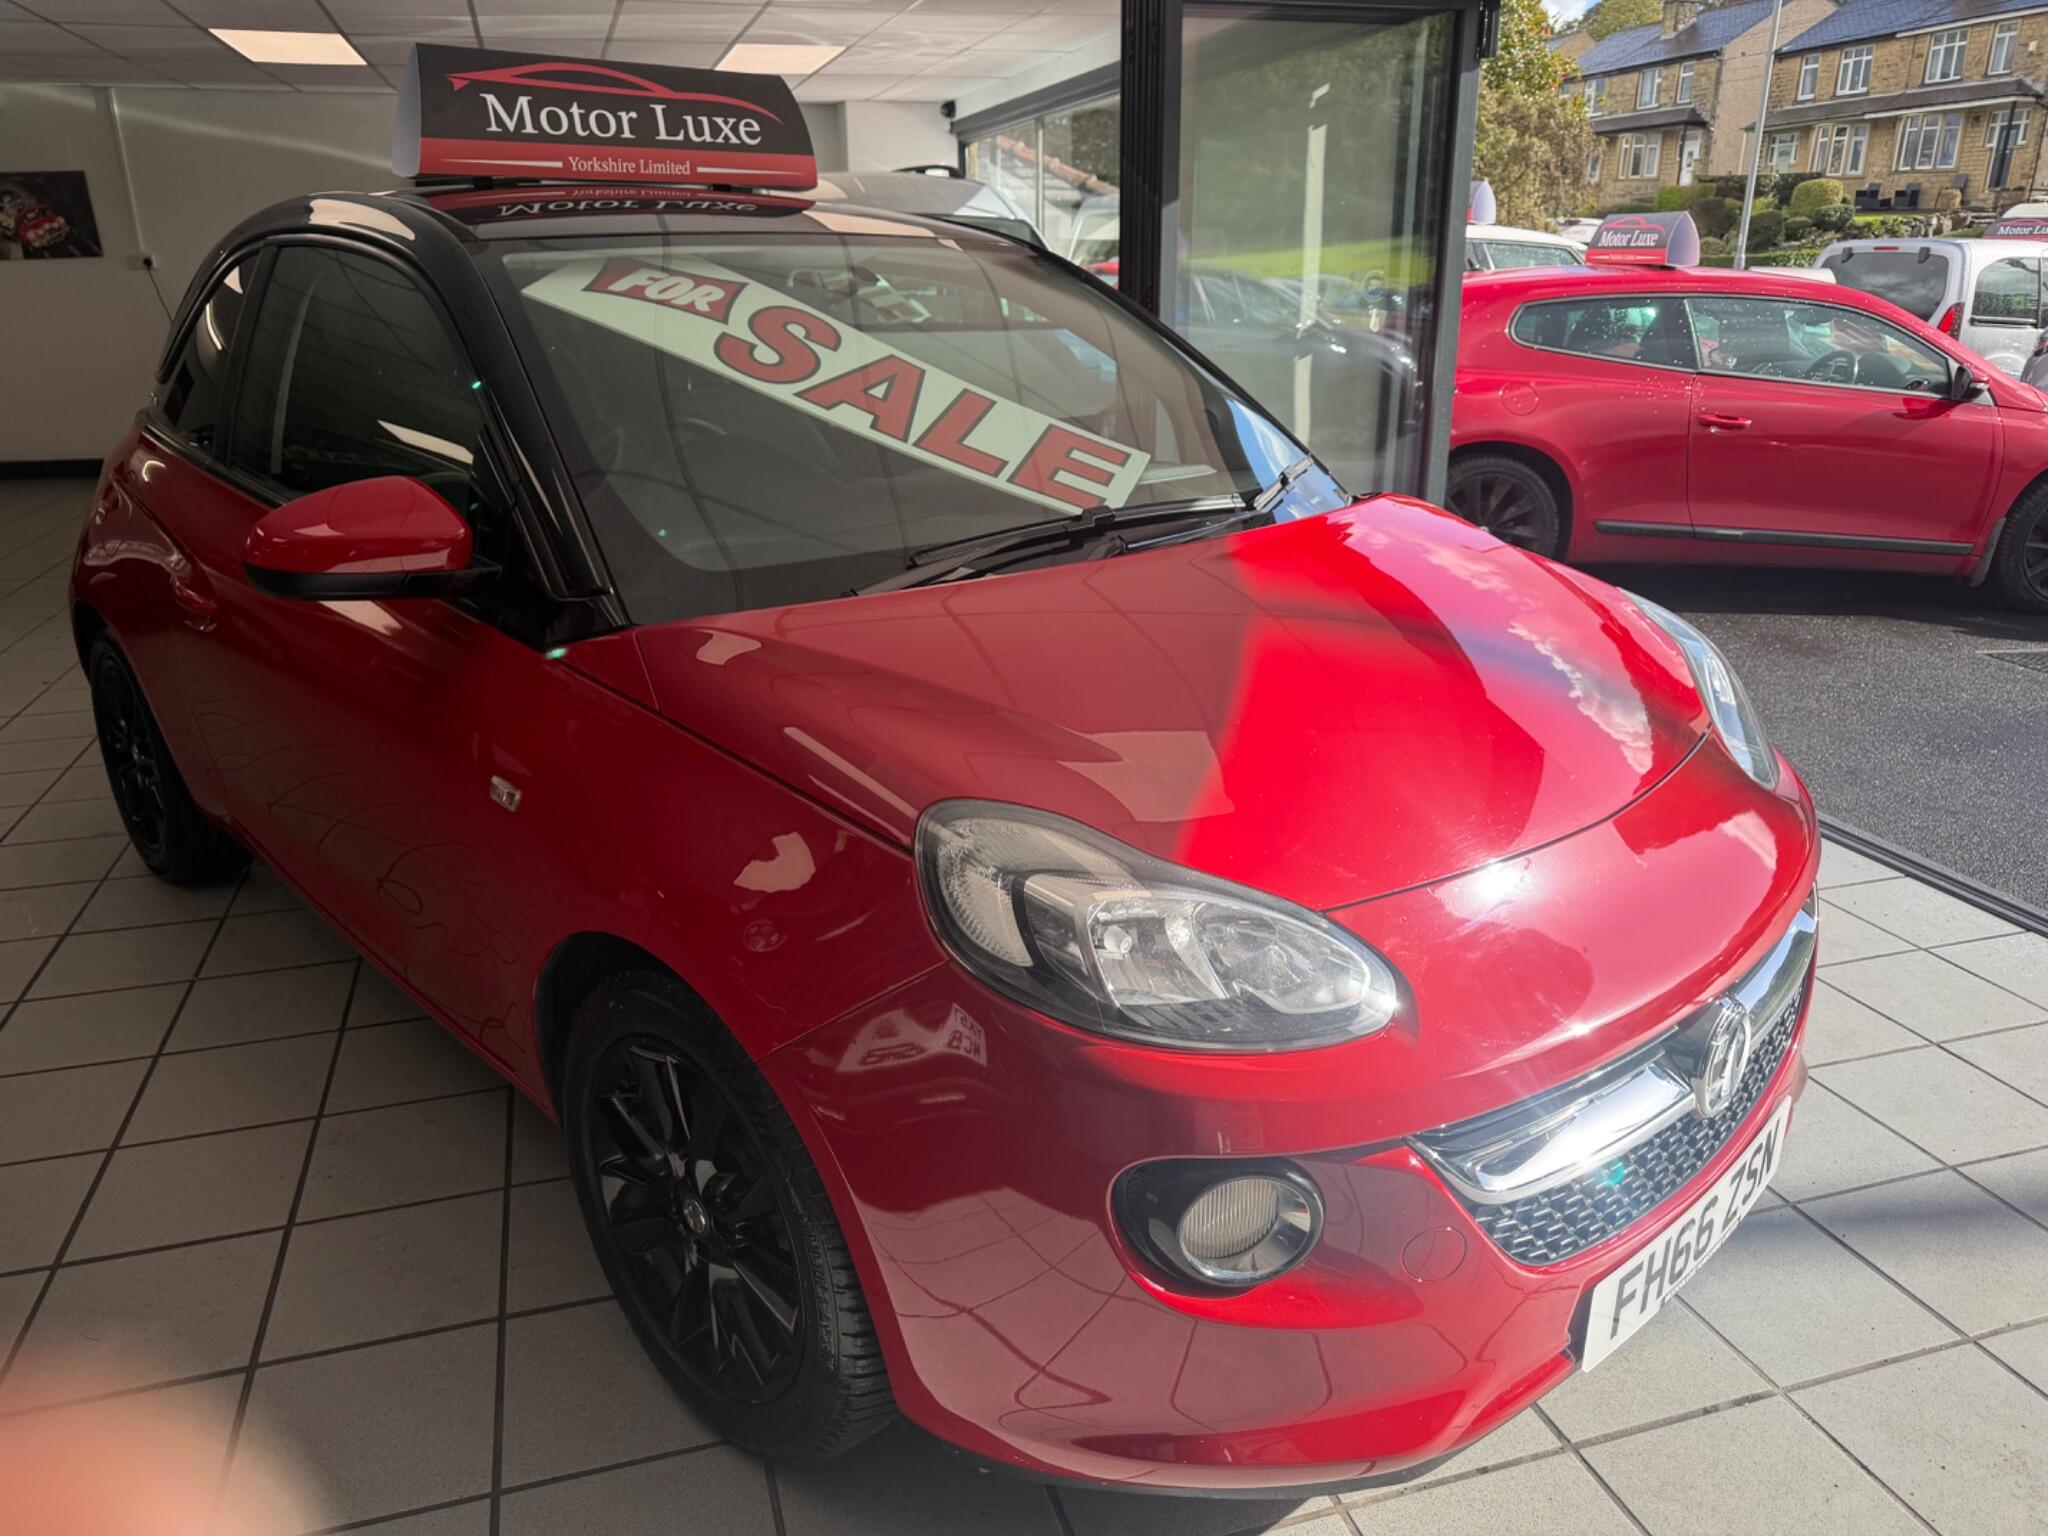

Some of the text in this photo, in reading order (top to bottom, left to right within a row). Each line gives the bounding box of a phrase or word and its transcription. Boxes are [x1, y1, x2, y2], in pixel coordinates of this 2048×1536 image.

[479, 92, 762, 146] Motor Luxe
[568, 156, 691, 176] Yorkshire Limited
[1599, 229, 1659, 247] Motor Luxe
[1997, 225, 2033, 236] Motor
[608, 266, 1132, 513] FOR SALE
[1609, 1194, 1719, 1341] FH66
[1720, 1118, 1781, 1234] ZSN
